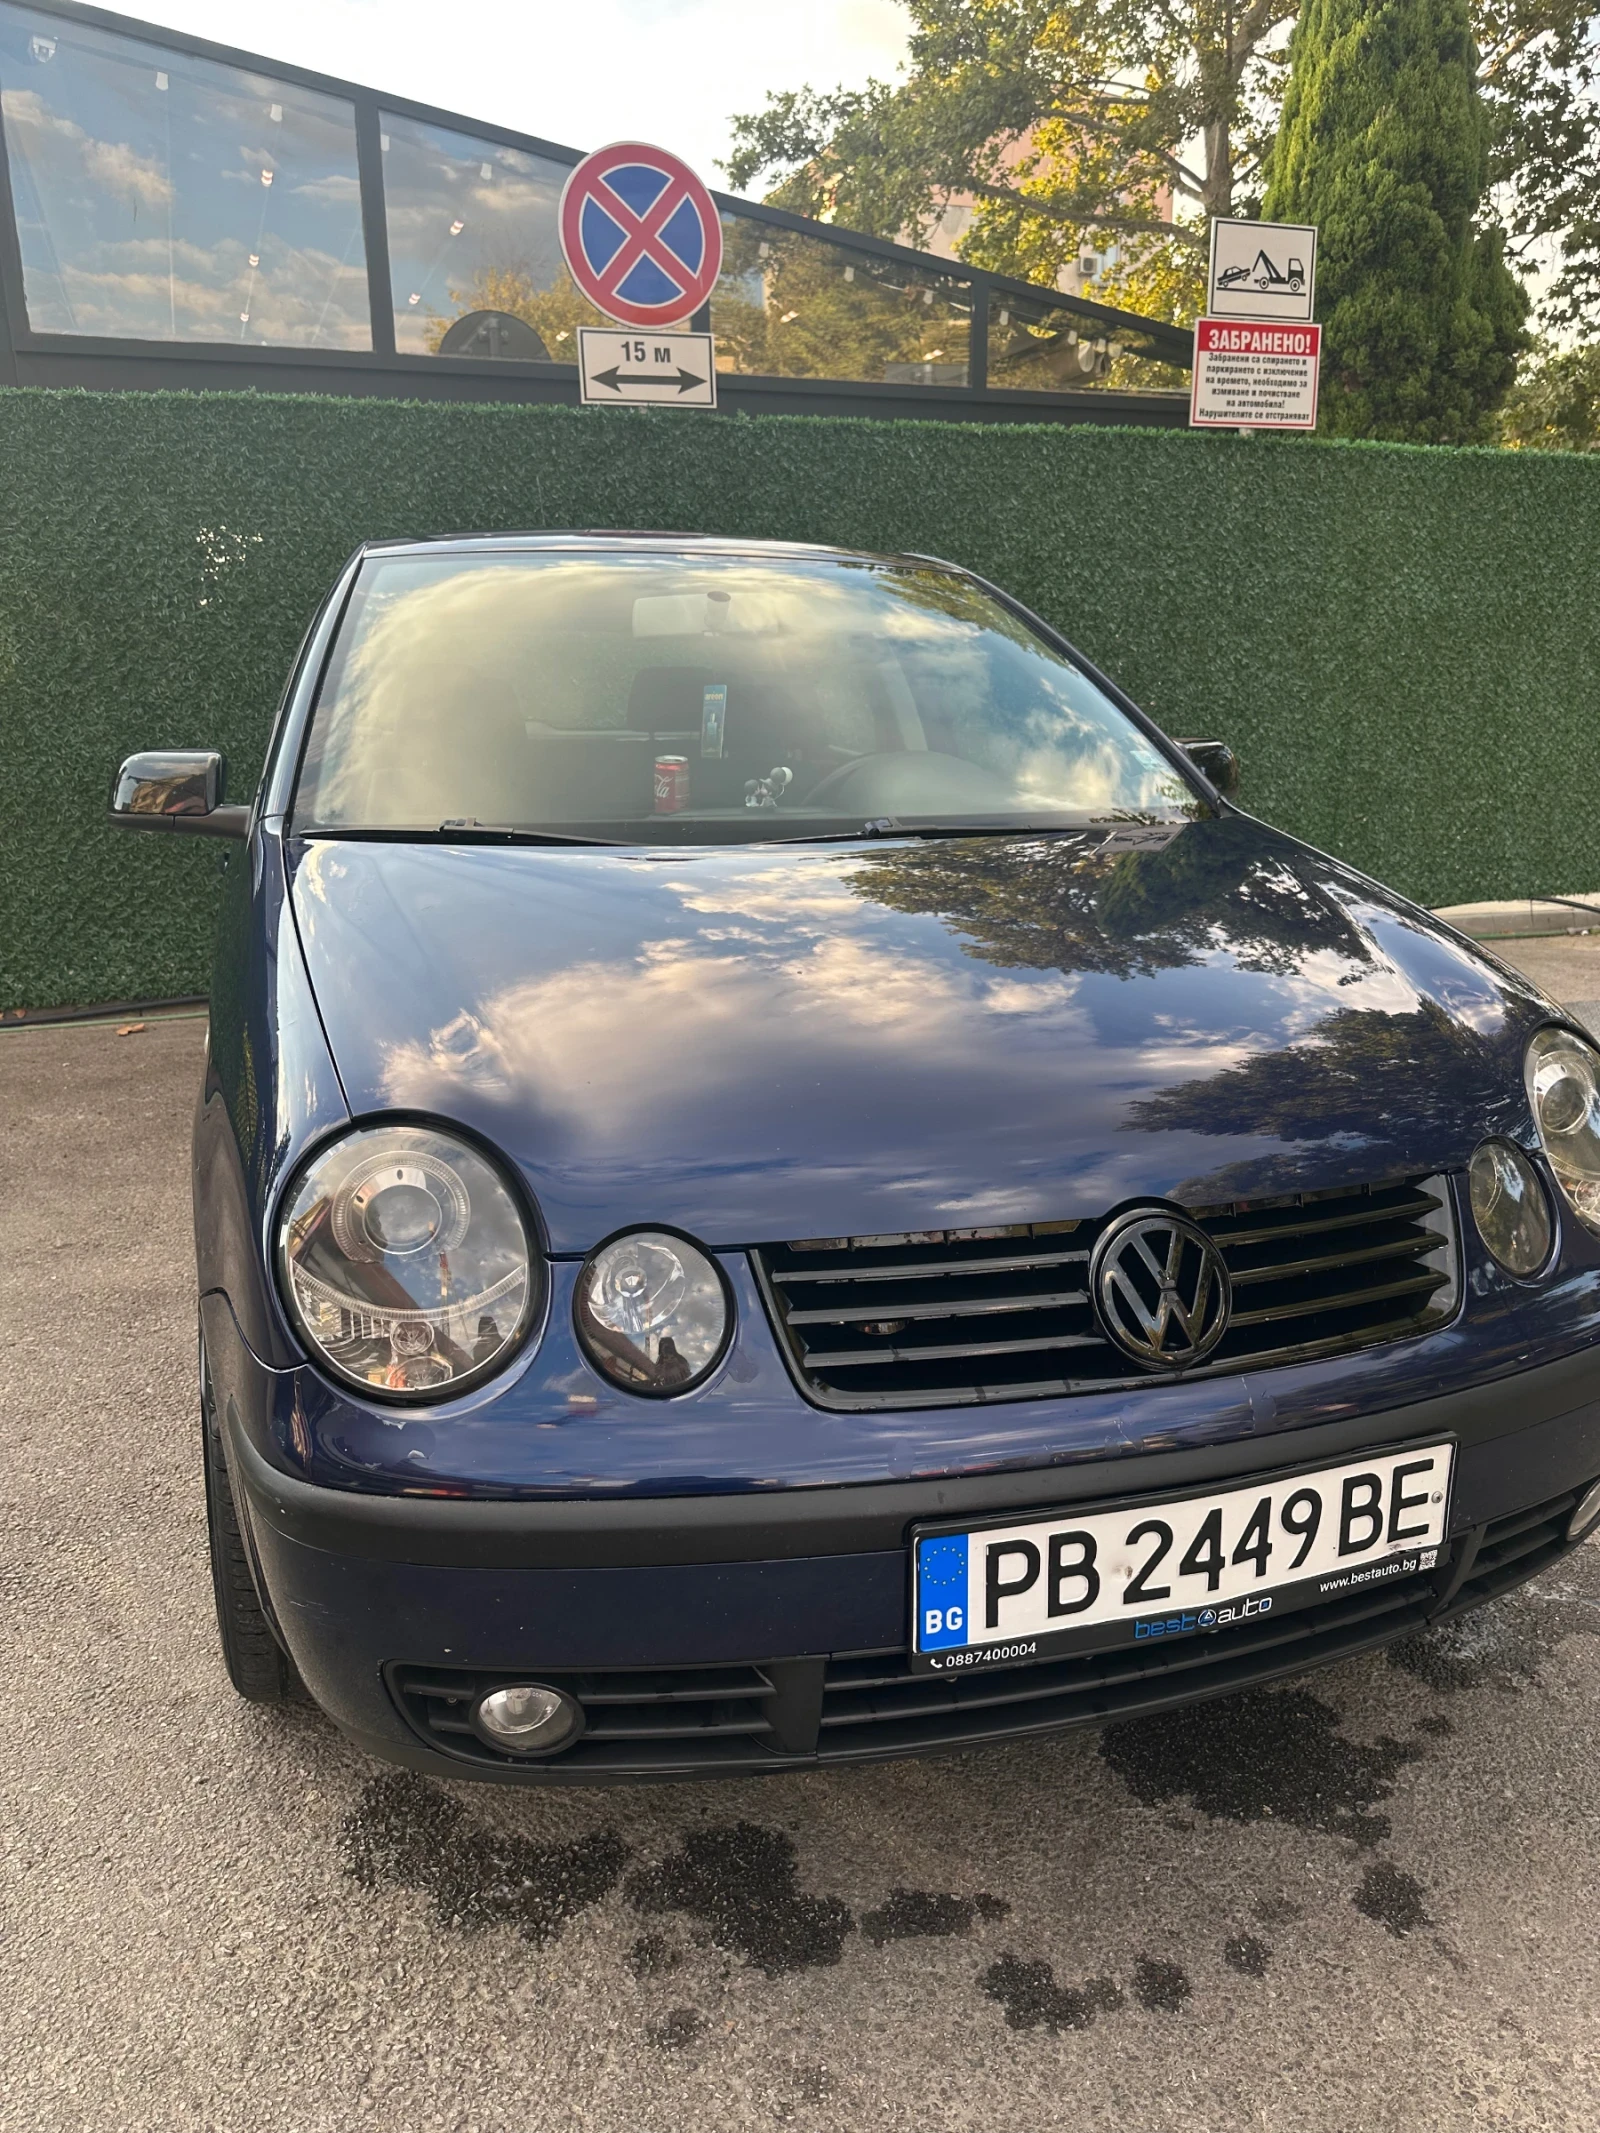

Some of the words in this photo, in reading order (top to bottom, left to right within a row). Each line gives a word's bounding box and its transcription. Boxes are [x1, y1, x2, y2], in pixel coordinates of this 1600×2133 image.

[1208, 329, 1311, 353] ЗАБРАНЕНО!
[620, 341, 646, 363] 15
[1208, 352, 1249, 363] Забранени
[1251, 355, 1260, 363] са
[1262, 356, 1300, 367] спирането
[1302, 358, 1307, 366] и
[1206, 365, 1255, 376] паркирането
[1263, 368, 1308, 377] изключение
[1205, 376, 1215, 384] на
[1217, 377, 1251, 387] времето,
[1252, 378, 1298, 388] необходимо
[1299, 380, 1308, 388] за
[1211, 388, 1250, 397] измиване
[1251, 389, 1257, 397] и
[1258, 389, 1301, 399] почистване
[1226, 399, 1236, 407] на
[1237, 399, 1286, 409] автомобила!
[1199, 408, 1253, 420] Нарушителите
[1254, 411, 1263, 419] се
[1265, 412, 1310, 421] отстраняват
[985, 1530, 1101, 1629] PB
[1122, 1488, 1323, 1605] 2449
[1337, 1459, 1435, 1559] BE
[1319, 1559, 1417, 1593] www.bestauto.bg
[925, 1606, 963, 1635] BG
[945, 1642, 1037, 1667] 0887400004
